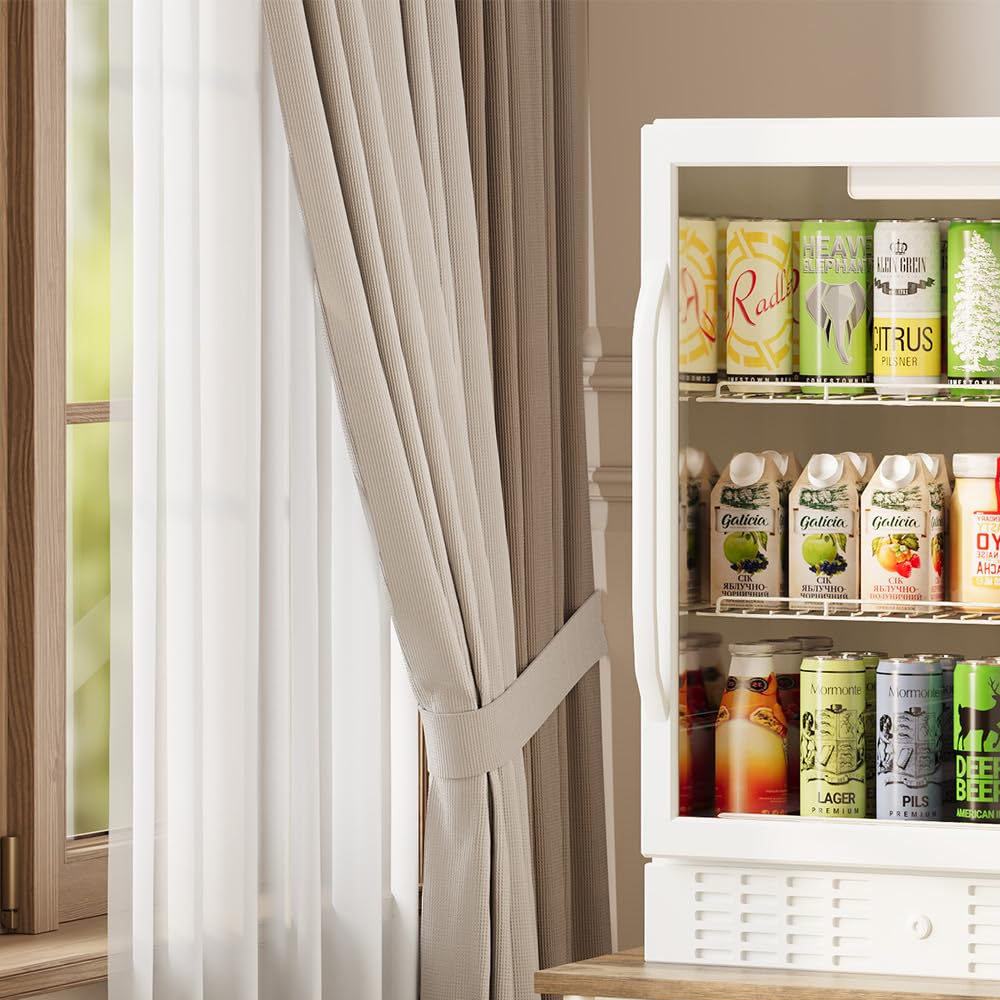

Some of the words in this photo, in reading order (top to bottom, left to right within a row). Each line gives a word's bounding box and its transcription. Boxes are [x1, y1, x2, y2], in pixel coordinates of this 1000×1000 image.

[881, 356, 918, 367] PILSNER
[721, 513, 769, 529] Galicia
[800, 515, 849, 530] Galicia
[872, 515, 920, 530] Galicia
[811, 683, 862, 696] Mormonte
[818, 792, 856, 804] LAGER
[902, 795, 930, 808] PILS
[812, 807, 859, 815] PREMIUM
[889, 810, 937, 818] PREMIUM
